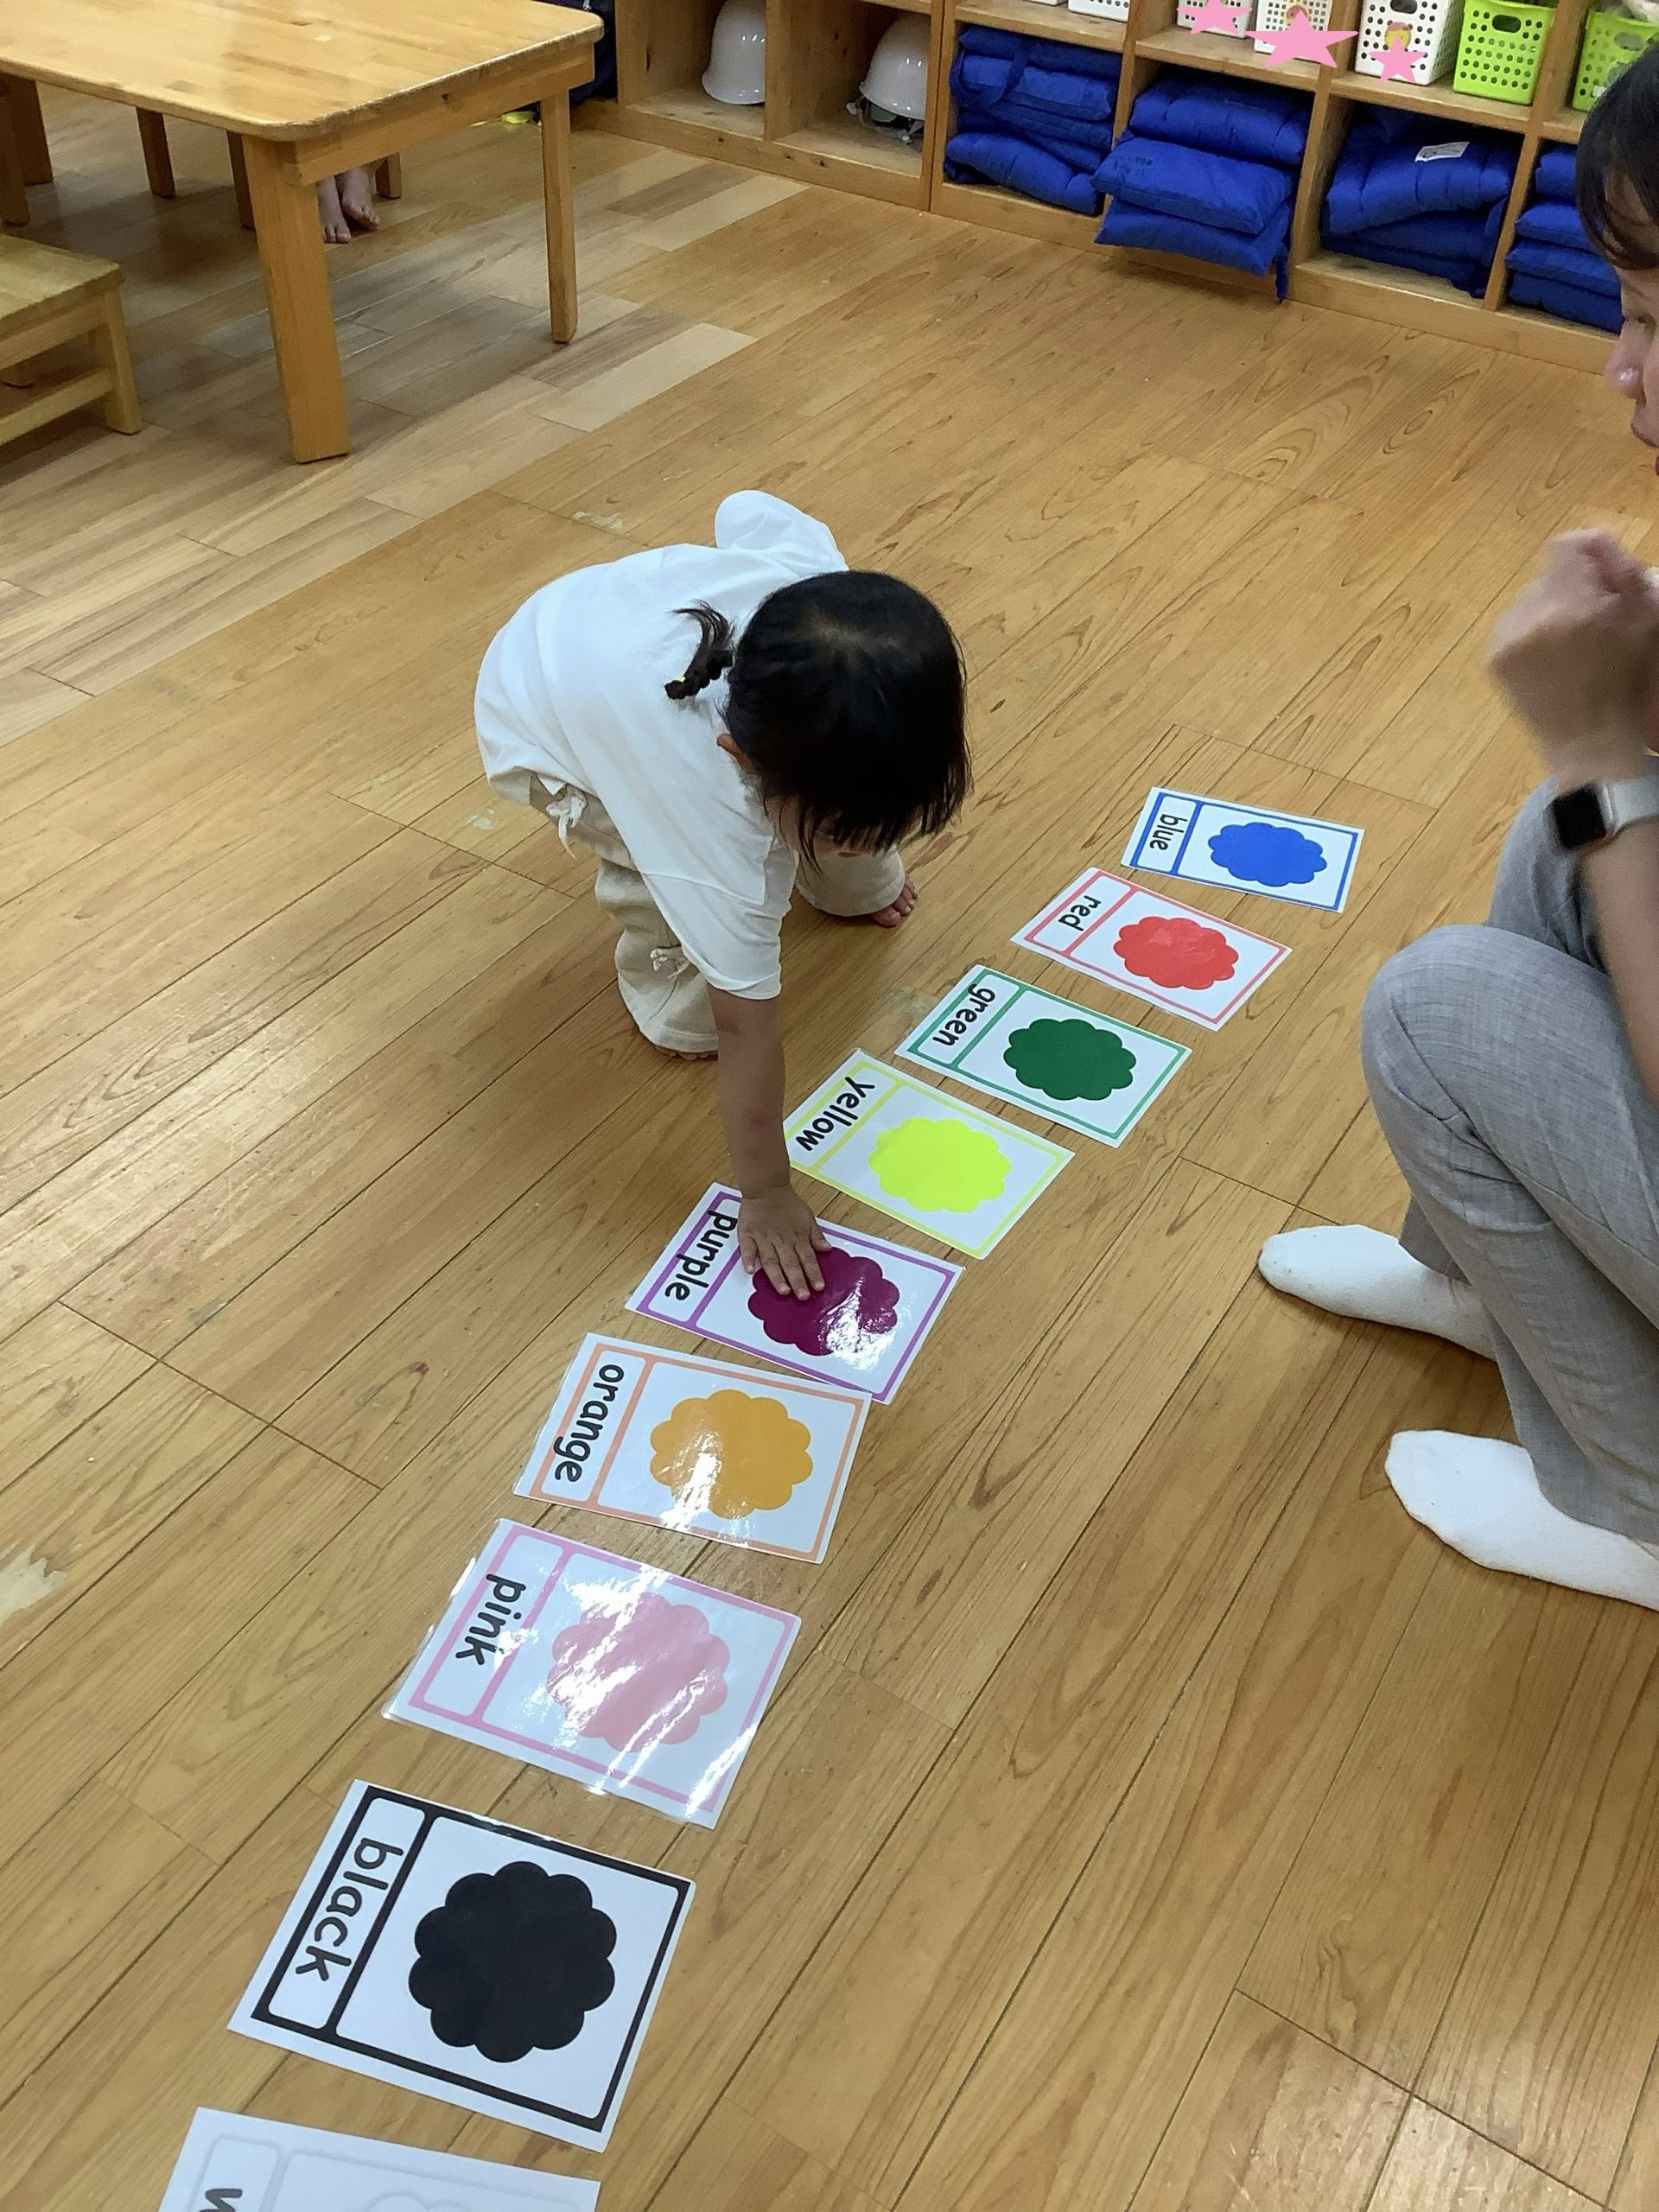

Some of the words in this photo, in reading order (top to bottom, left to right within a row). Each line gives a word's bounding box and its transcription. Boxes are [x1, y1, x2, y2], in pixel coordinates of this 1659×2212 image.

[1149, 812, 1189, 851] blue
[1057, 894, 1103, 931] red
[931, 982, 996, 1047] green
[794, 1075, 876, 1152] yellow
[664, 1209, 739, 1301] purple
[552, 1363, 626, 1483] orange
[454, 1573, 527, 1666] pink
[294, 1836, 404, 1982] black
